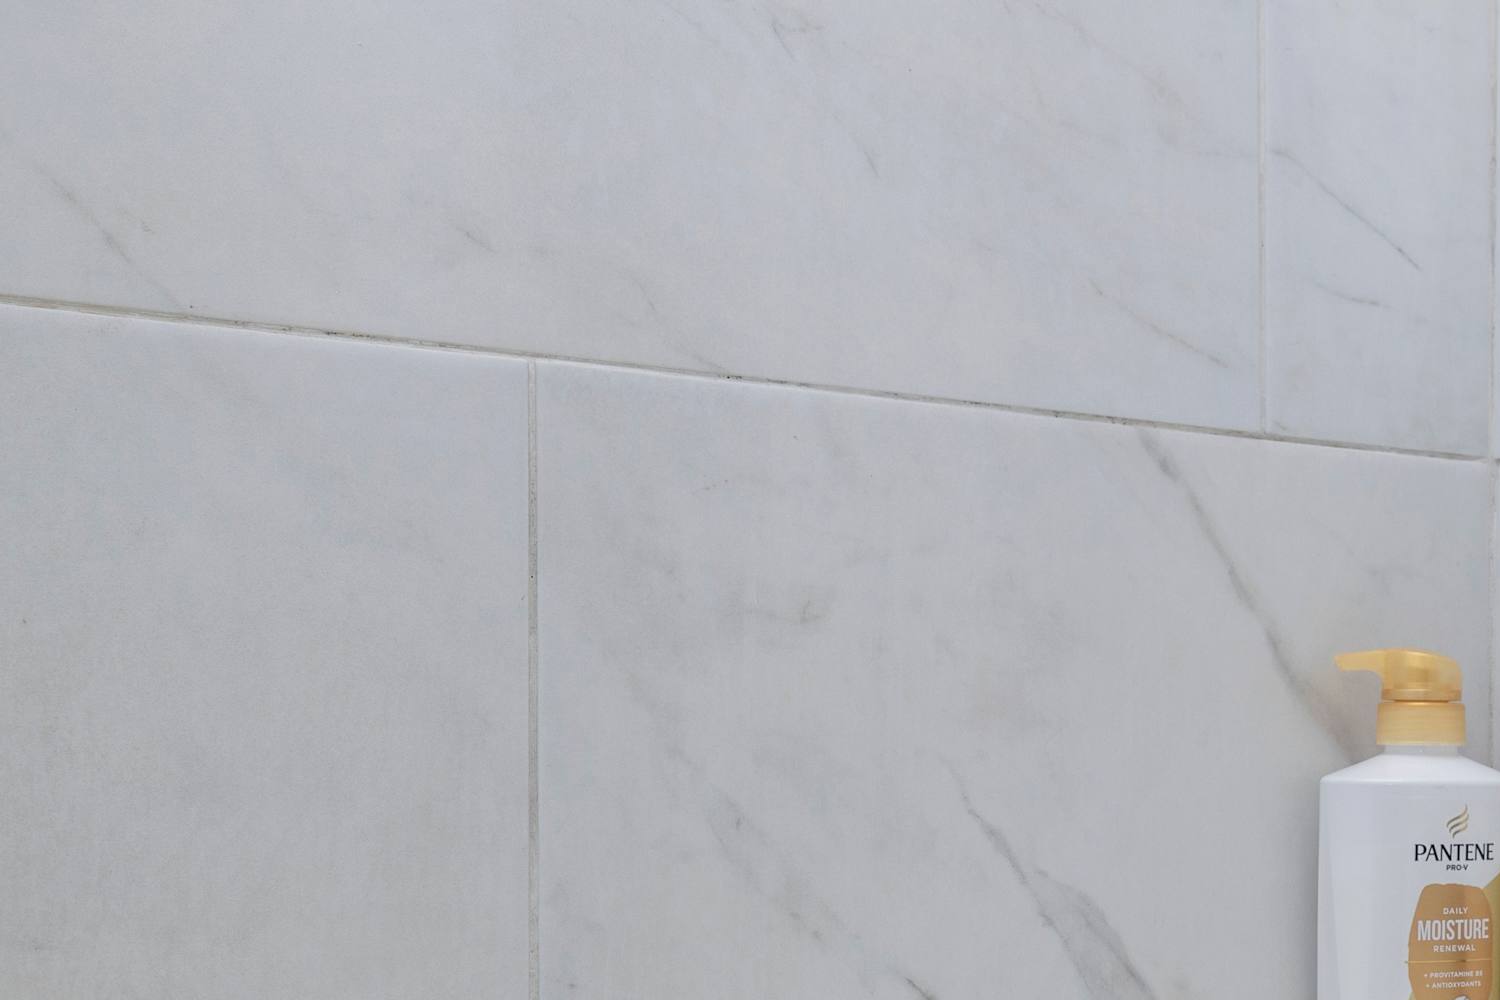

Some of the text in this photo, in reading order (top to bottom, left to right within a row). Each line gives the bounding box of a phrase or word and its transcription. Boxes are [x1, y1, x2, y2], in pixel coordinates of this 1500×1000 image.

[1414, 842, 1495, 862] PANTENE
[1442, 906, 1469, 915] DAILY
[1417, 918, 1490, 941] MOISTURE
[1432, 944, 1477, 953] RENEWAL
